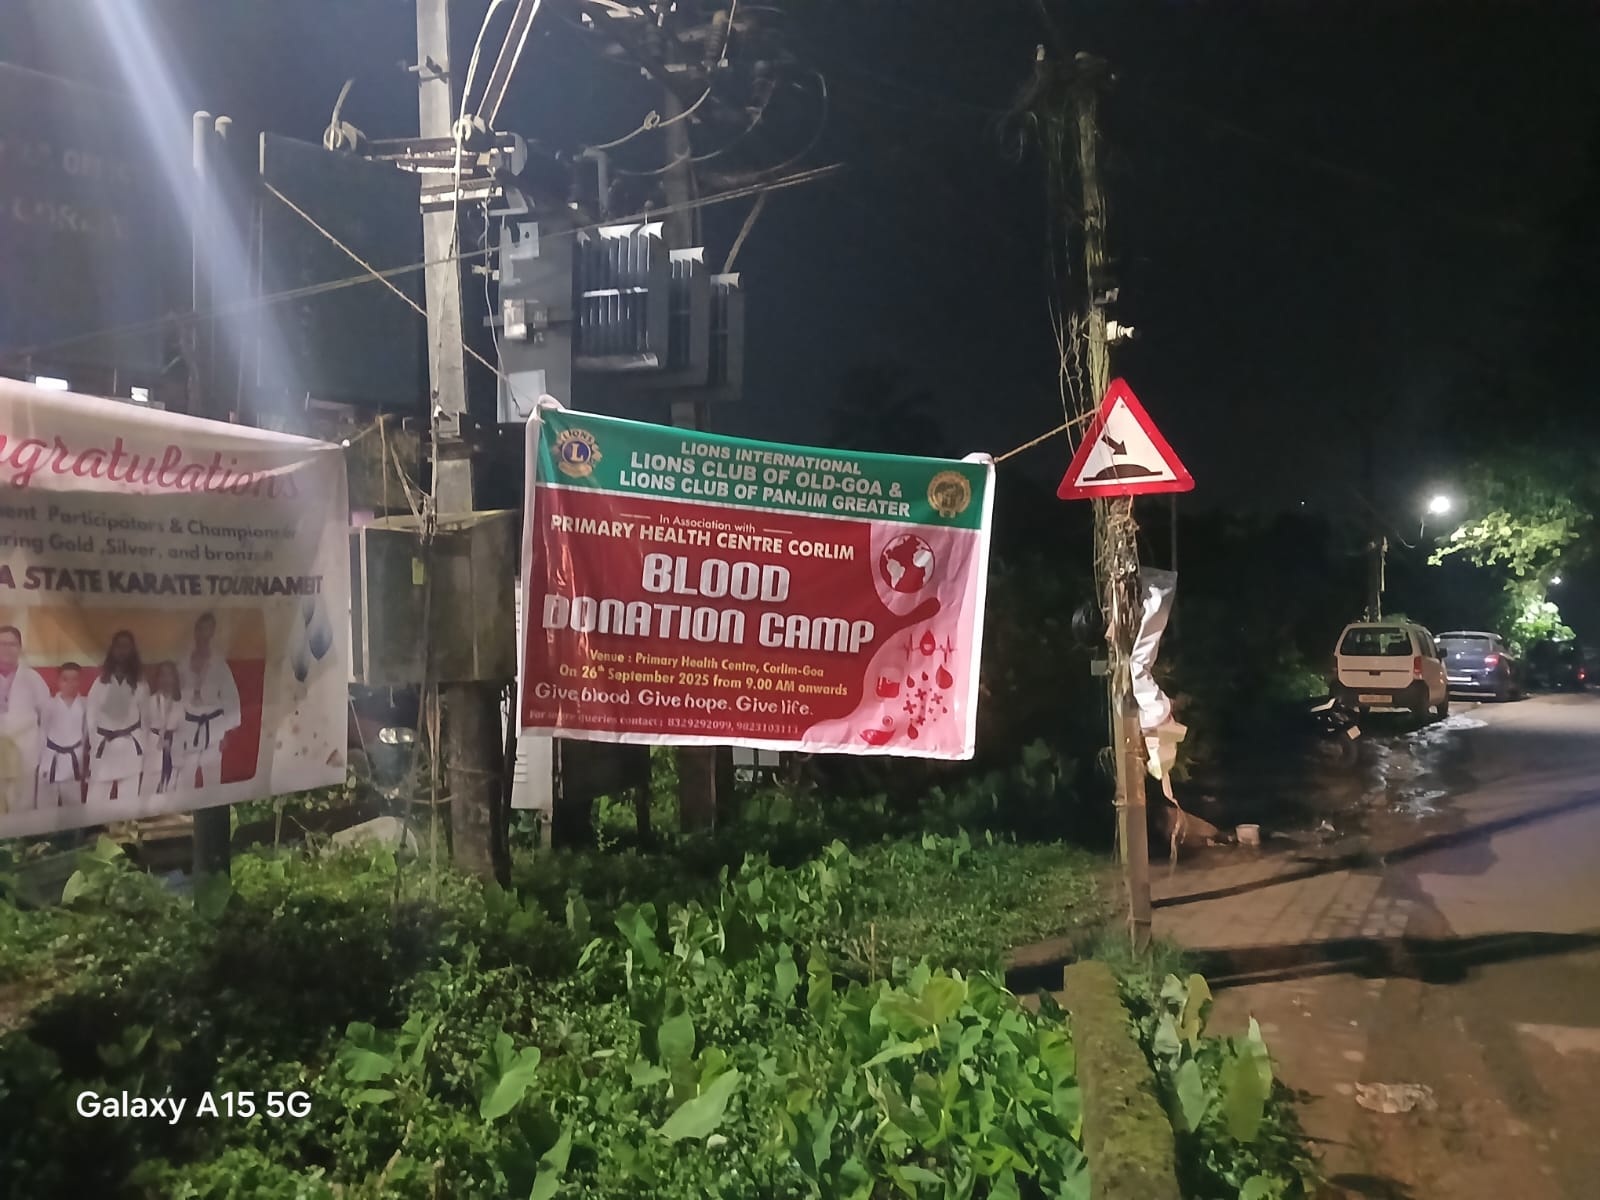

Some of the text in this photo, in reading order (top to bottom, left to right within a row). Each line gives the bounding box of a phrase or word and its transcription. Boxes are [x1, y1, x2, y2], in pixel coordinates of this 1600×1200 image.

[571, 443, 584, 462] L
[681, 441, 862, 475] LIONS INTERNATIONAL
[631, 452, 695, 475] LIONS
[702, 461, 757, 482] CLUB
[763, 468, 790, 484] OF
[796, 471, 882, 496] OLD-GOA
[889, 482, 902, 498] &
[620, 471, 910, 517] LIONS CLUB OF PANJIM GREATER
[170, 518, 184, 534] &
[551, 515, 854, 561] PRIMARY HEALTH CENTRE CORLIM
[659, 514, 756, 534] In Association with
[49, 533, 94, 553] Gold
[168, 545, 199, 560] and
[23, 566, 103, 593] STATE
[108, 570, 202, 595] KARATE
[642, 553, 790, 602] BLOOD
[542, 593, 875, 653] DONATION CAMP
[559, 663, 577, 677] On
[607, 667, 674, 685] September
[678, 672, 709, 687] 2025
[713, 674, 742, 689] from
[746, 678, 773, 691] 9.00
[775, 679, 795, 693] AM
[798, 681, 848, 696] onwards
[590, 649, 625, 663] Venue
[635, 652, 679, 669] Primary
[681, 655, 718, 670] Health
[721, 659, 759, 674] Centre,
[763, 662, 824, 678] Corlim-Goa
[535, 682, 578, 701] Give
[638, 689, 681, 708] Give
[684, 693, 732, 714] hope.
[736, 695, 778, 713] Give
[781, 699, 814, 716] life.
